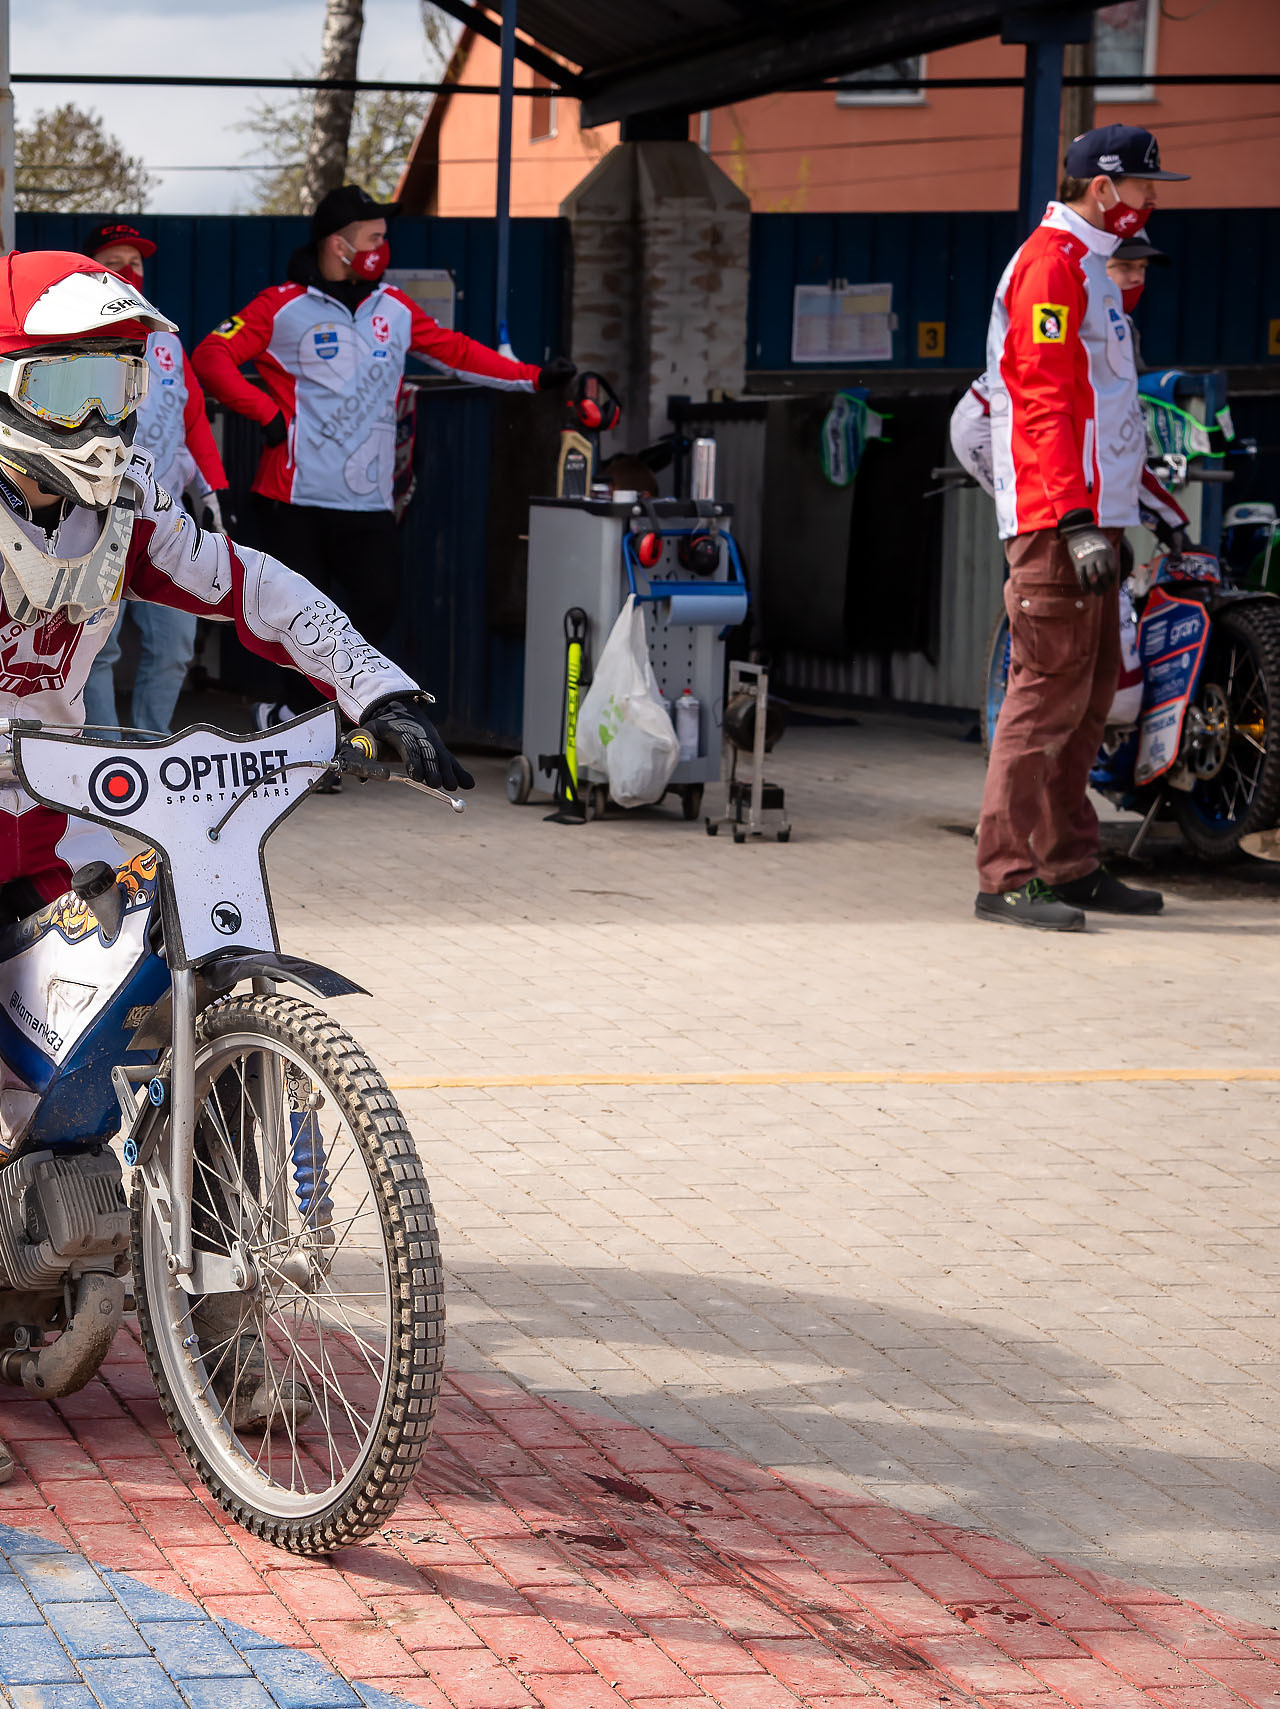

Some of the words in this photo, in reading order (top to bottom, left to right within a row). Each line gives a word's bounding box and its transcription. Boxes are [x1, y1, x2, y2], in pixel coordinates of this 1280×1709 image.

[925, 327, 938, 351] 3
[159, 749, 289, 792] OPTIBET
[166, 791, 238, 805] SPORTA
[252, 787, 290, 799] BĀRS
